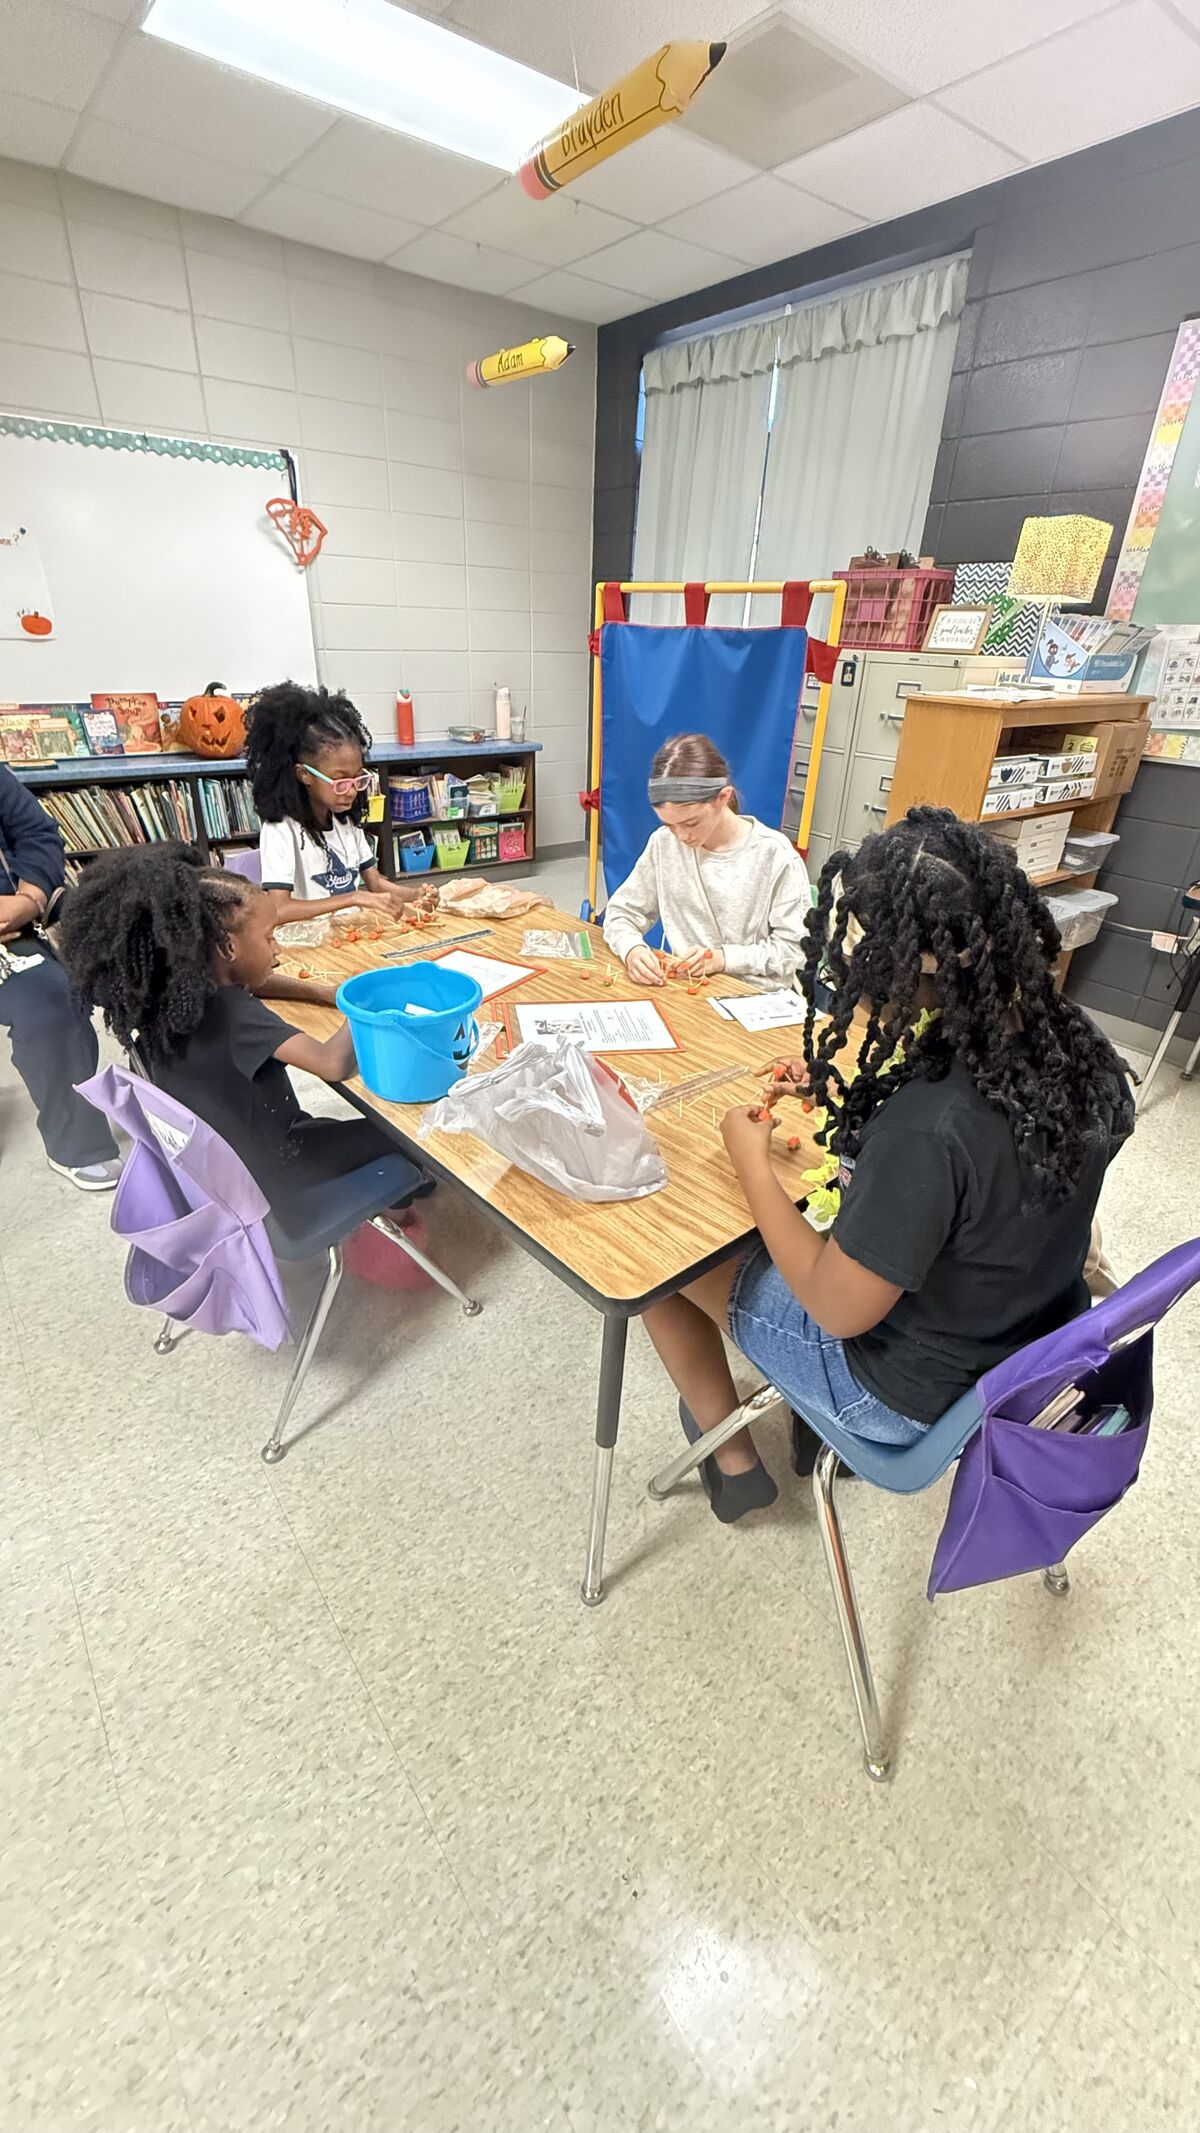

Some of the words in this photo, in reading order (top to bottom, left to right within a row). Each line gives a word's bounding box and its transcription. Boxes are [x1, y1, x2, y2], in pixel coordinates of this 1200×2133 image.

[560, 92, 625, 157] Brayden
[497, 352, 524, 373] Adam
[104, 695, 147, 708] Pumpkin
[117, 705, 142, 717] Soup
[1067, 742, 1074, 751] 2
